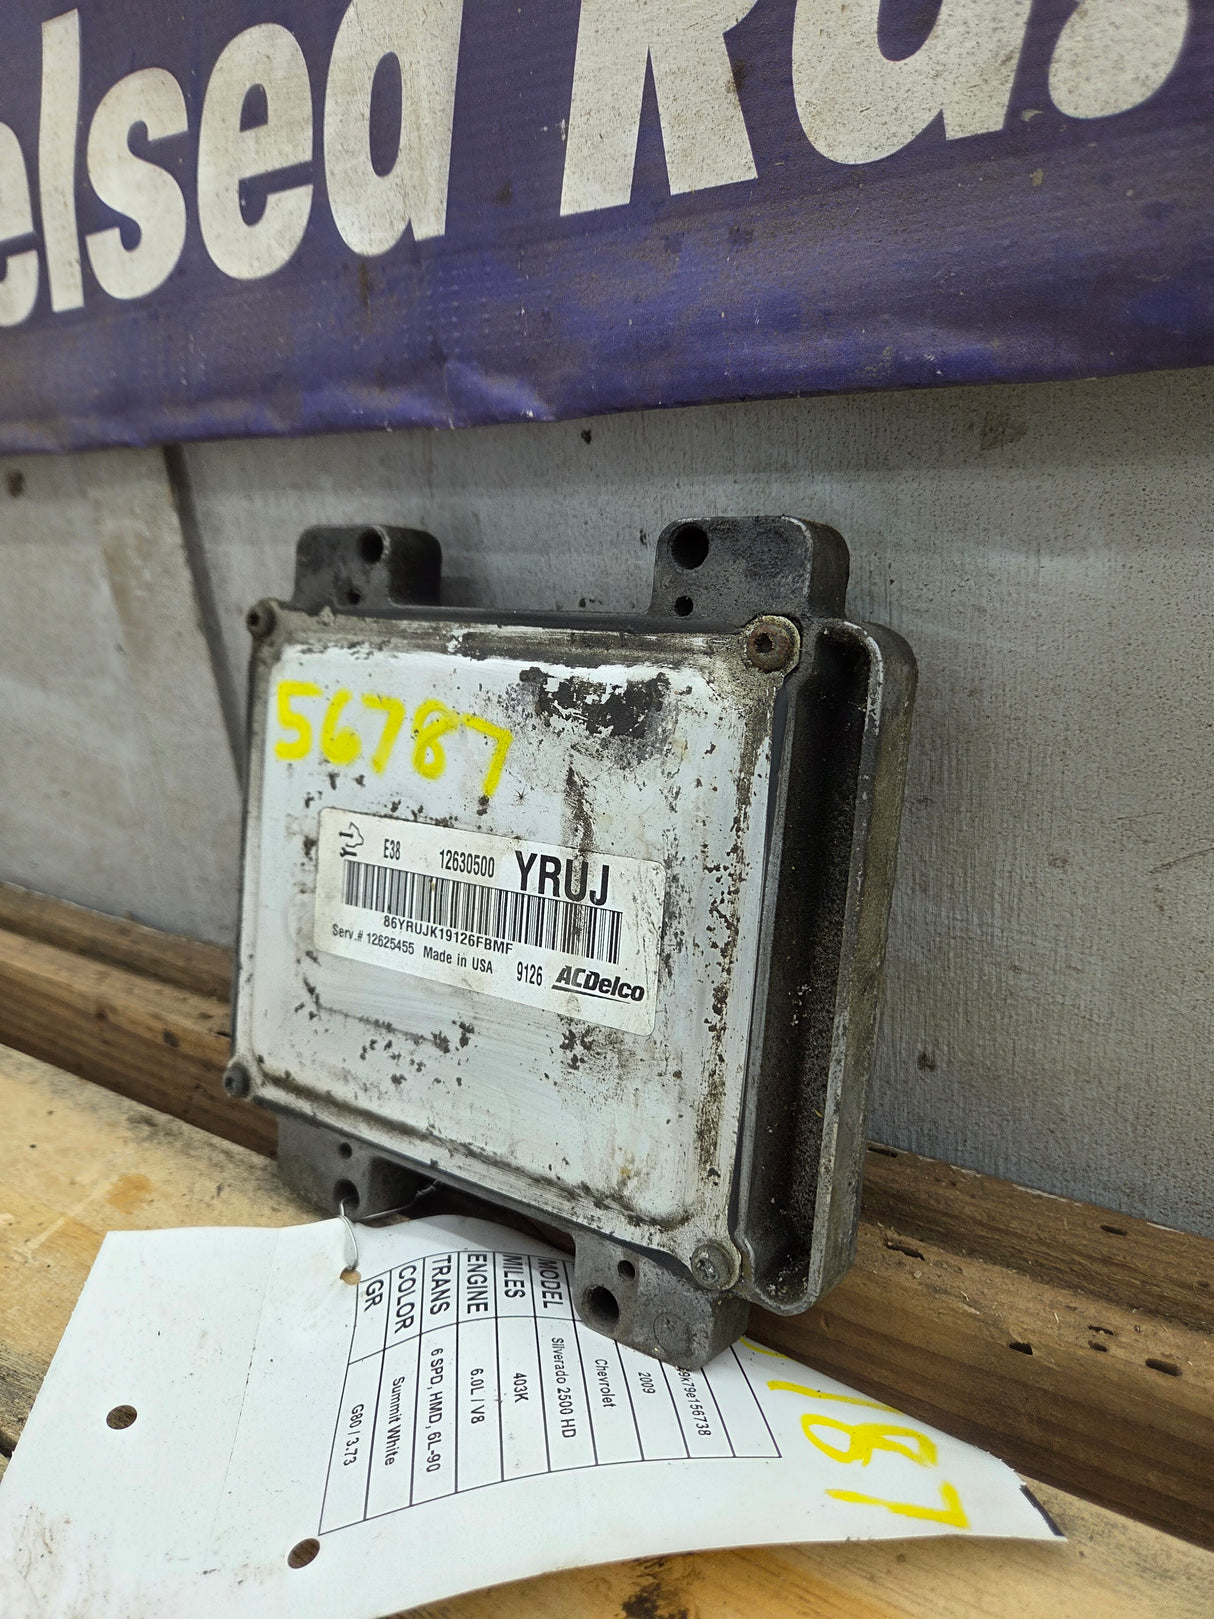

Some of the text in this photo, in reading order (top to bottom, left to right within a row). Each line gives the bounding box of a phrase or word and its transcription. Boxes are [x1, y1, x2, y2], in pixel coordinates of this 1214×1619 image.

[274, 680, 513, 798] 56787
[384, 838, 610, 906] E38 12630500 YRUJ
[366, 932, 415, 955] 12625455
[423, 945, 452, 964] Made
[457, 953, 467, 967] in
[472, 957, 493, 974] USA
[516, 961, 543, 987] 9126
[383, 915, 514, 956] 86YRUJK19126FBMF
[552, 965, 645, 1003] ACDelco
[364, 1279, 385, 1313] GR
[394, 1264, 417, 1335] COLOR
[429, 1254, 452, 1315] TRANS
[466, 1253, 489, 1315] ENGINE
[502, 1254, 526, 1299] MILES
[537, 1257, 564, 1309] MODEL
[470, 1368, 484, 1396] 6.0L
[513, 1372, 529, 1403] 403K
[551, 1337, 577, 1439] Silverado 2500 HD
[594, 1358, 617, 1408] Chevrolet
[638, 1371, 656, 1395] 2009
[677, 1369, 712, 1437] 9k79e156738
[349, 1403, 365, 1429] G80
[384, 1376, 406, 1467] Summit White
[425, 1346, 445, 1473] 6 SPD, HMD, 6L-90
[470, 1404, 485, 1425] V8
[343, 1437, 360, 1467] 3.73
